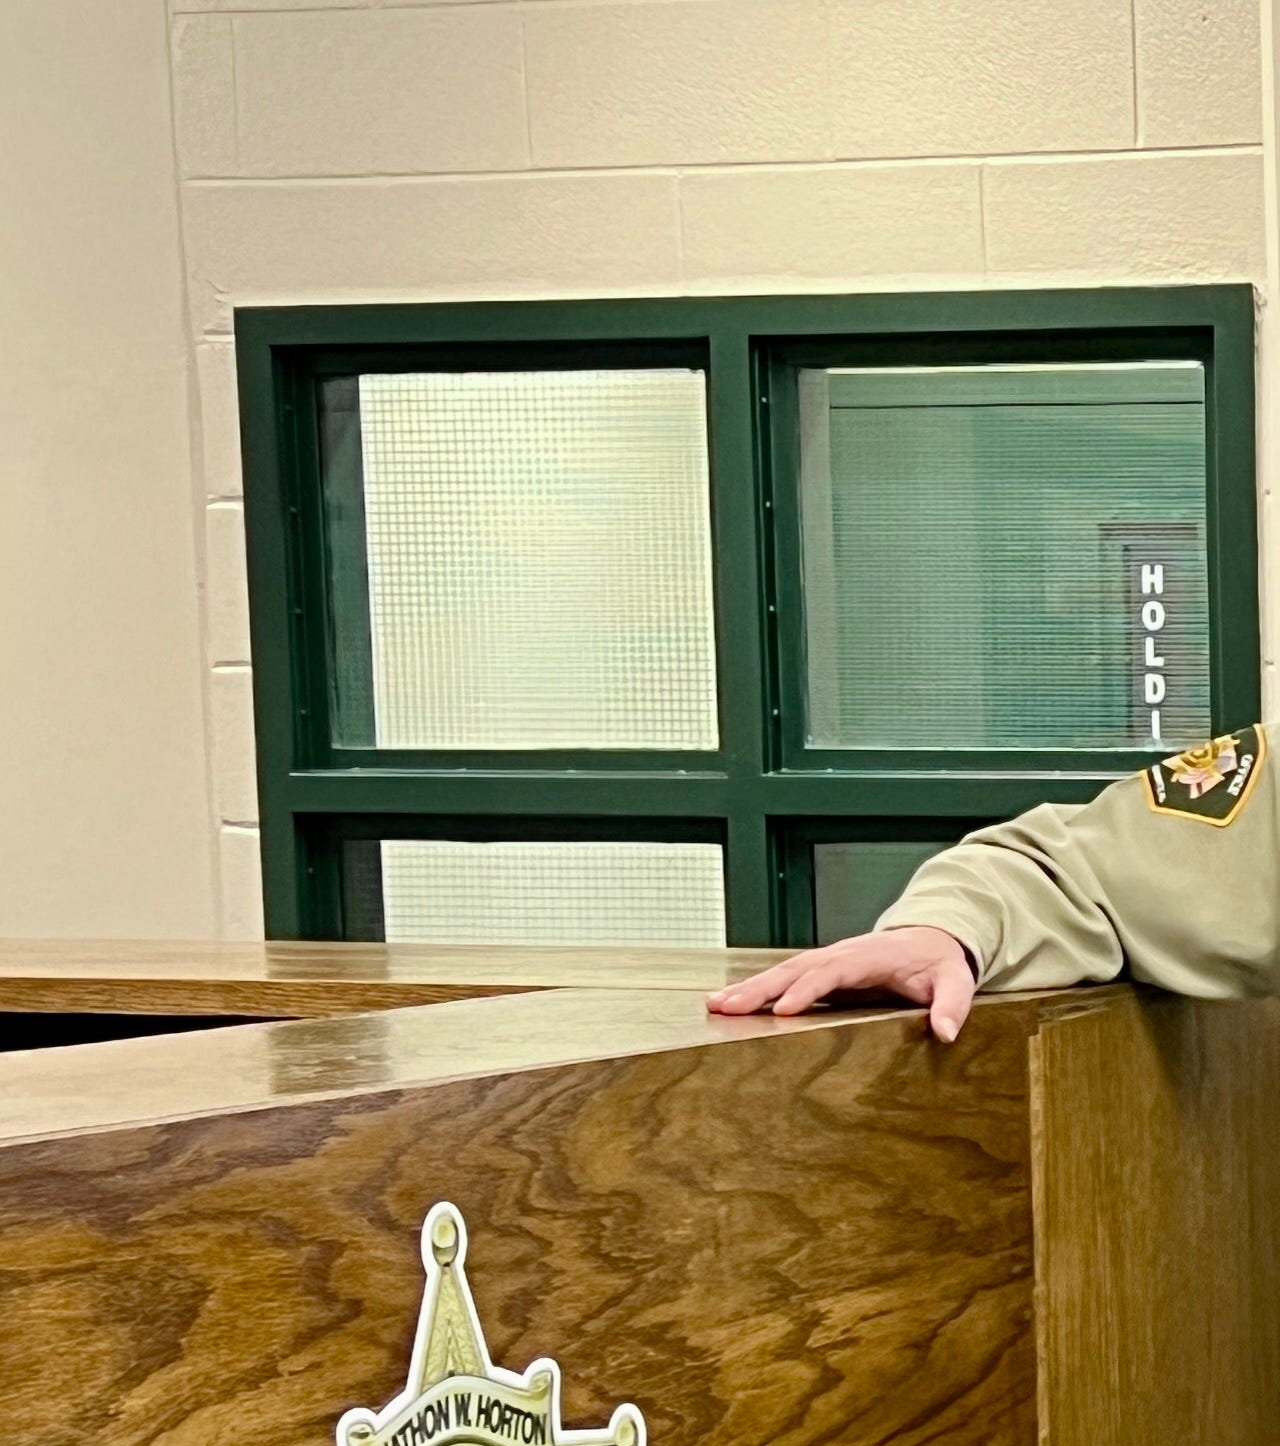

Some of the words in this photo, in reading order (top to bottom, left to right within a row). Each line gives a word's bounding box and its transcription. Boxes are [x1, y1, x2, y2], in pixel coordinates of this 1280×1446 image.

[1141, 564, 1166, 740] HOLDI
[454, 1392, 472, 1427] W.
[476, 1394, 548, 1446] HORTON
